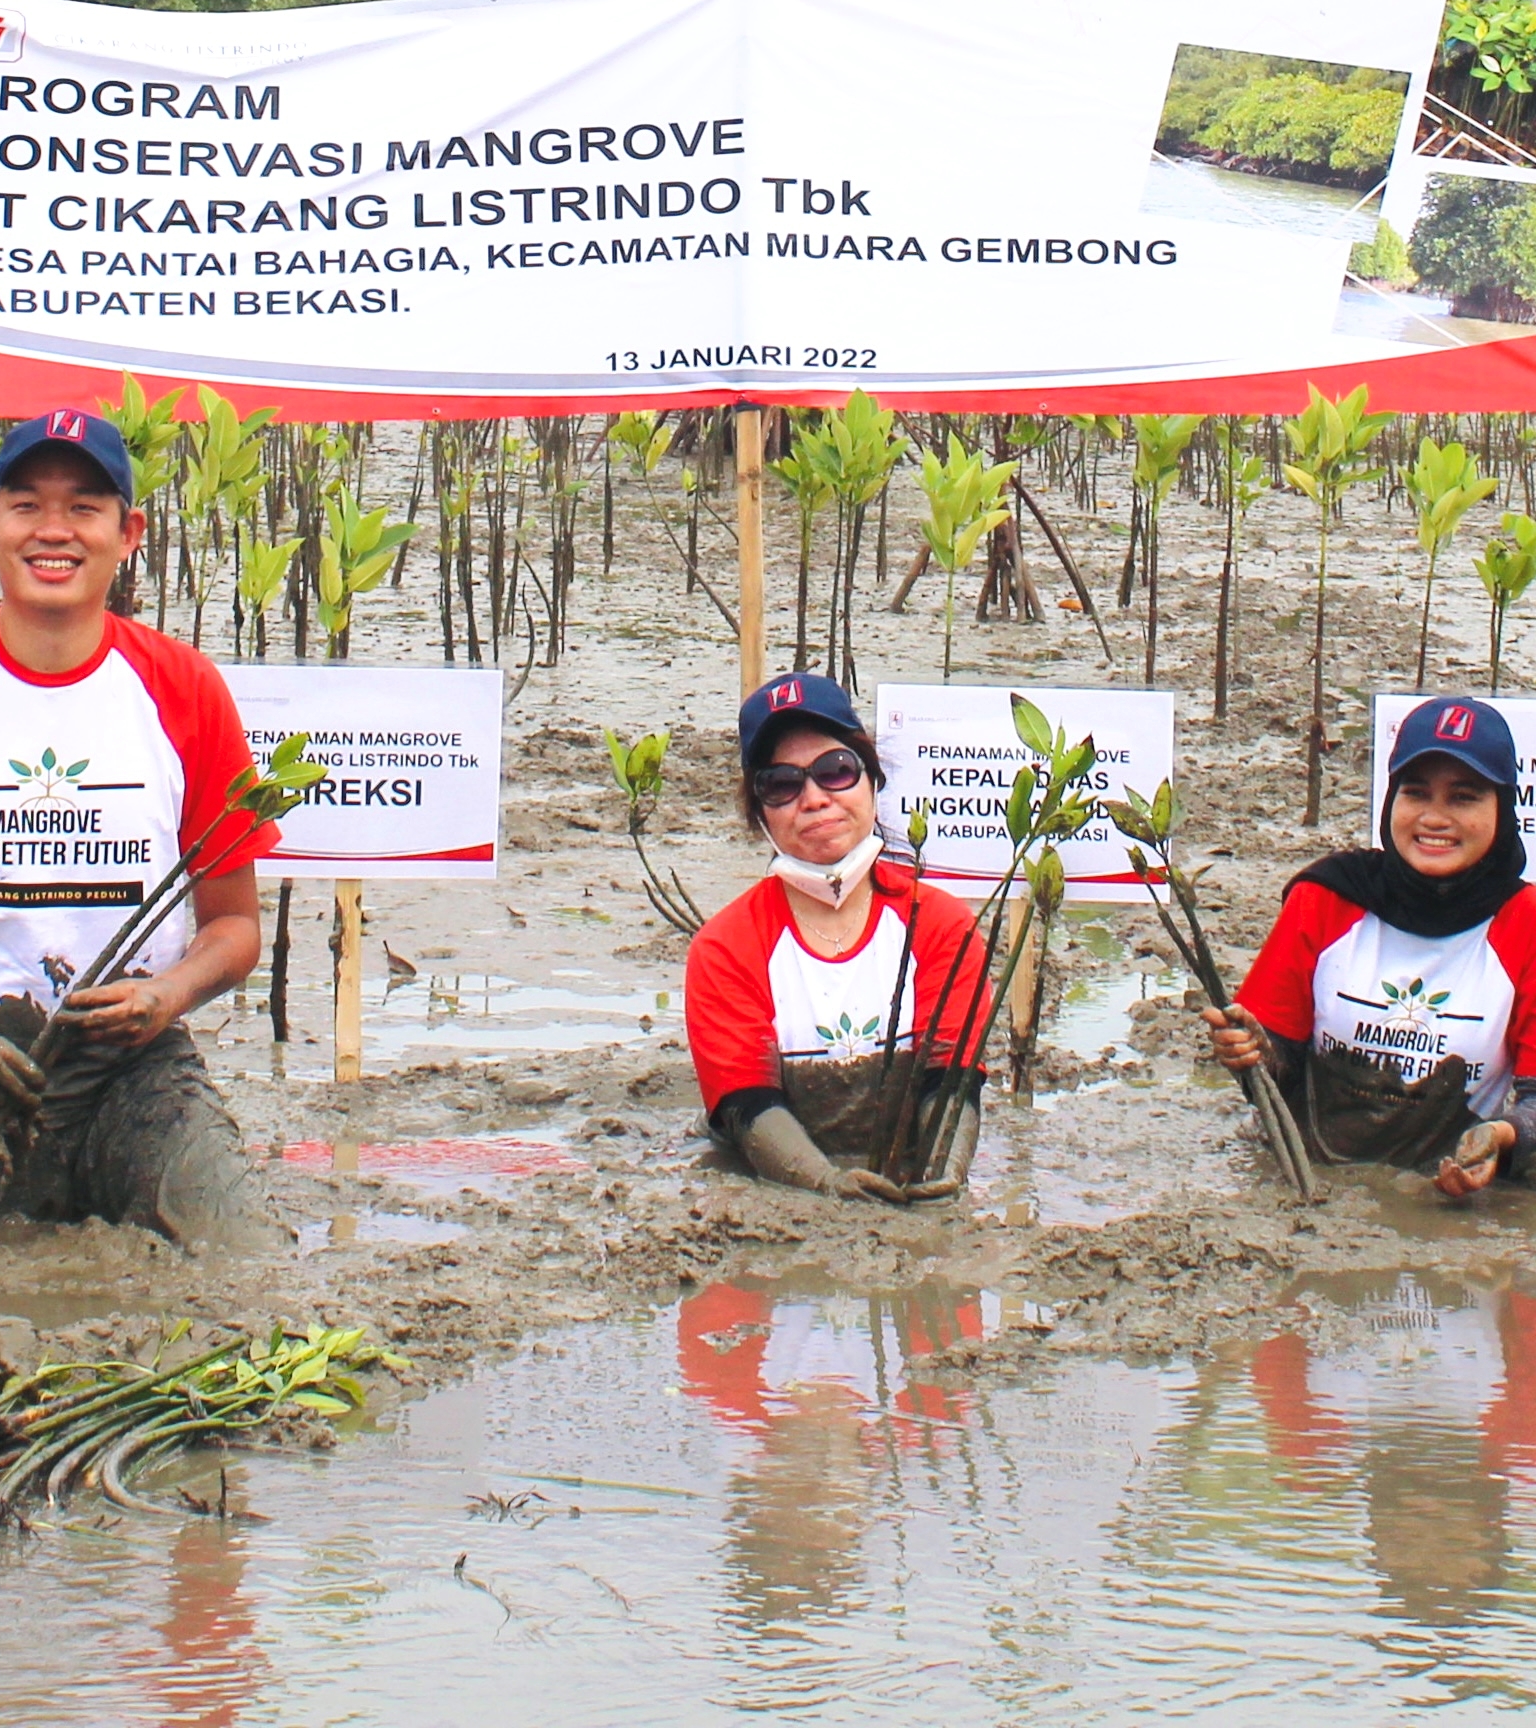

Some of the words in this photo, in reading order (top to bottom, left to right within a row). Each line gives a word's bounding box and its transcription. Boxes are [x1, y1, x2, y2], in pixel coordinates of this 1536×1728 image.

[385, 118, 746, 171] MANGROVE
[48, 194, 389, 230] CIKARANG
[414, 178, 741, 228] LISTRINDO
[762, 177, 872, 216] Tbk
[82, 251, 237, 276] PANTAI
[255, 249, 471, 275] BAHAGIA,
[487, 232, 750, 269] KECAMATAN
[766, 233, 927, 262] MUARA
[941, 237, 1177, 265] GEMBONG
[234, 289, 410, 314] BEKASI.
[606, 351, 639, 372] 13
[650, 345, 791, 366] JANUARI
[803, 347, 877, 369] 2022
[359, 732, 462, 747] MANGROVE
[350, 753, 442, 767] LISTRINDO
[449, 754, 479, 768] Tbk
[918, 746, 1026, 760] PENANAMAN
[932, 768, 1016, 788] KEPAL
[74, 839, 151, 865] FUTURE
[24, 891, 81, 900] LISTRINDO
[86, 891, 126, 899] PEDULI
[1354, 1022, 1447, 1054] MANGROVE
